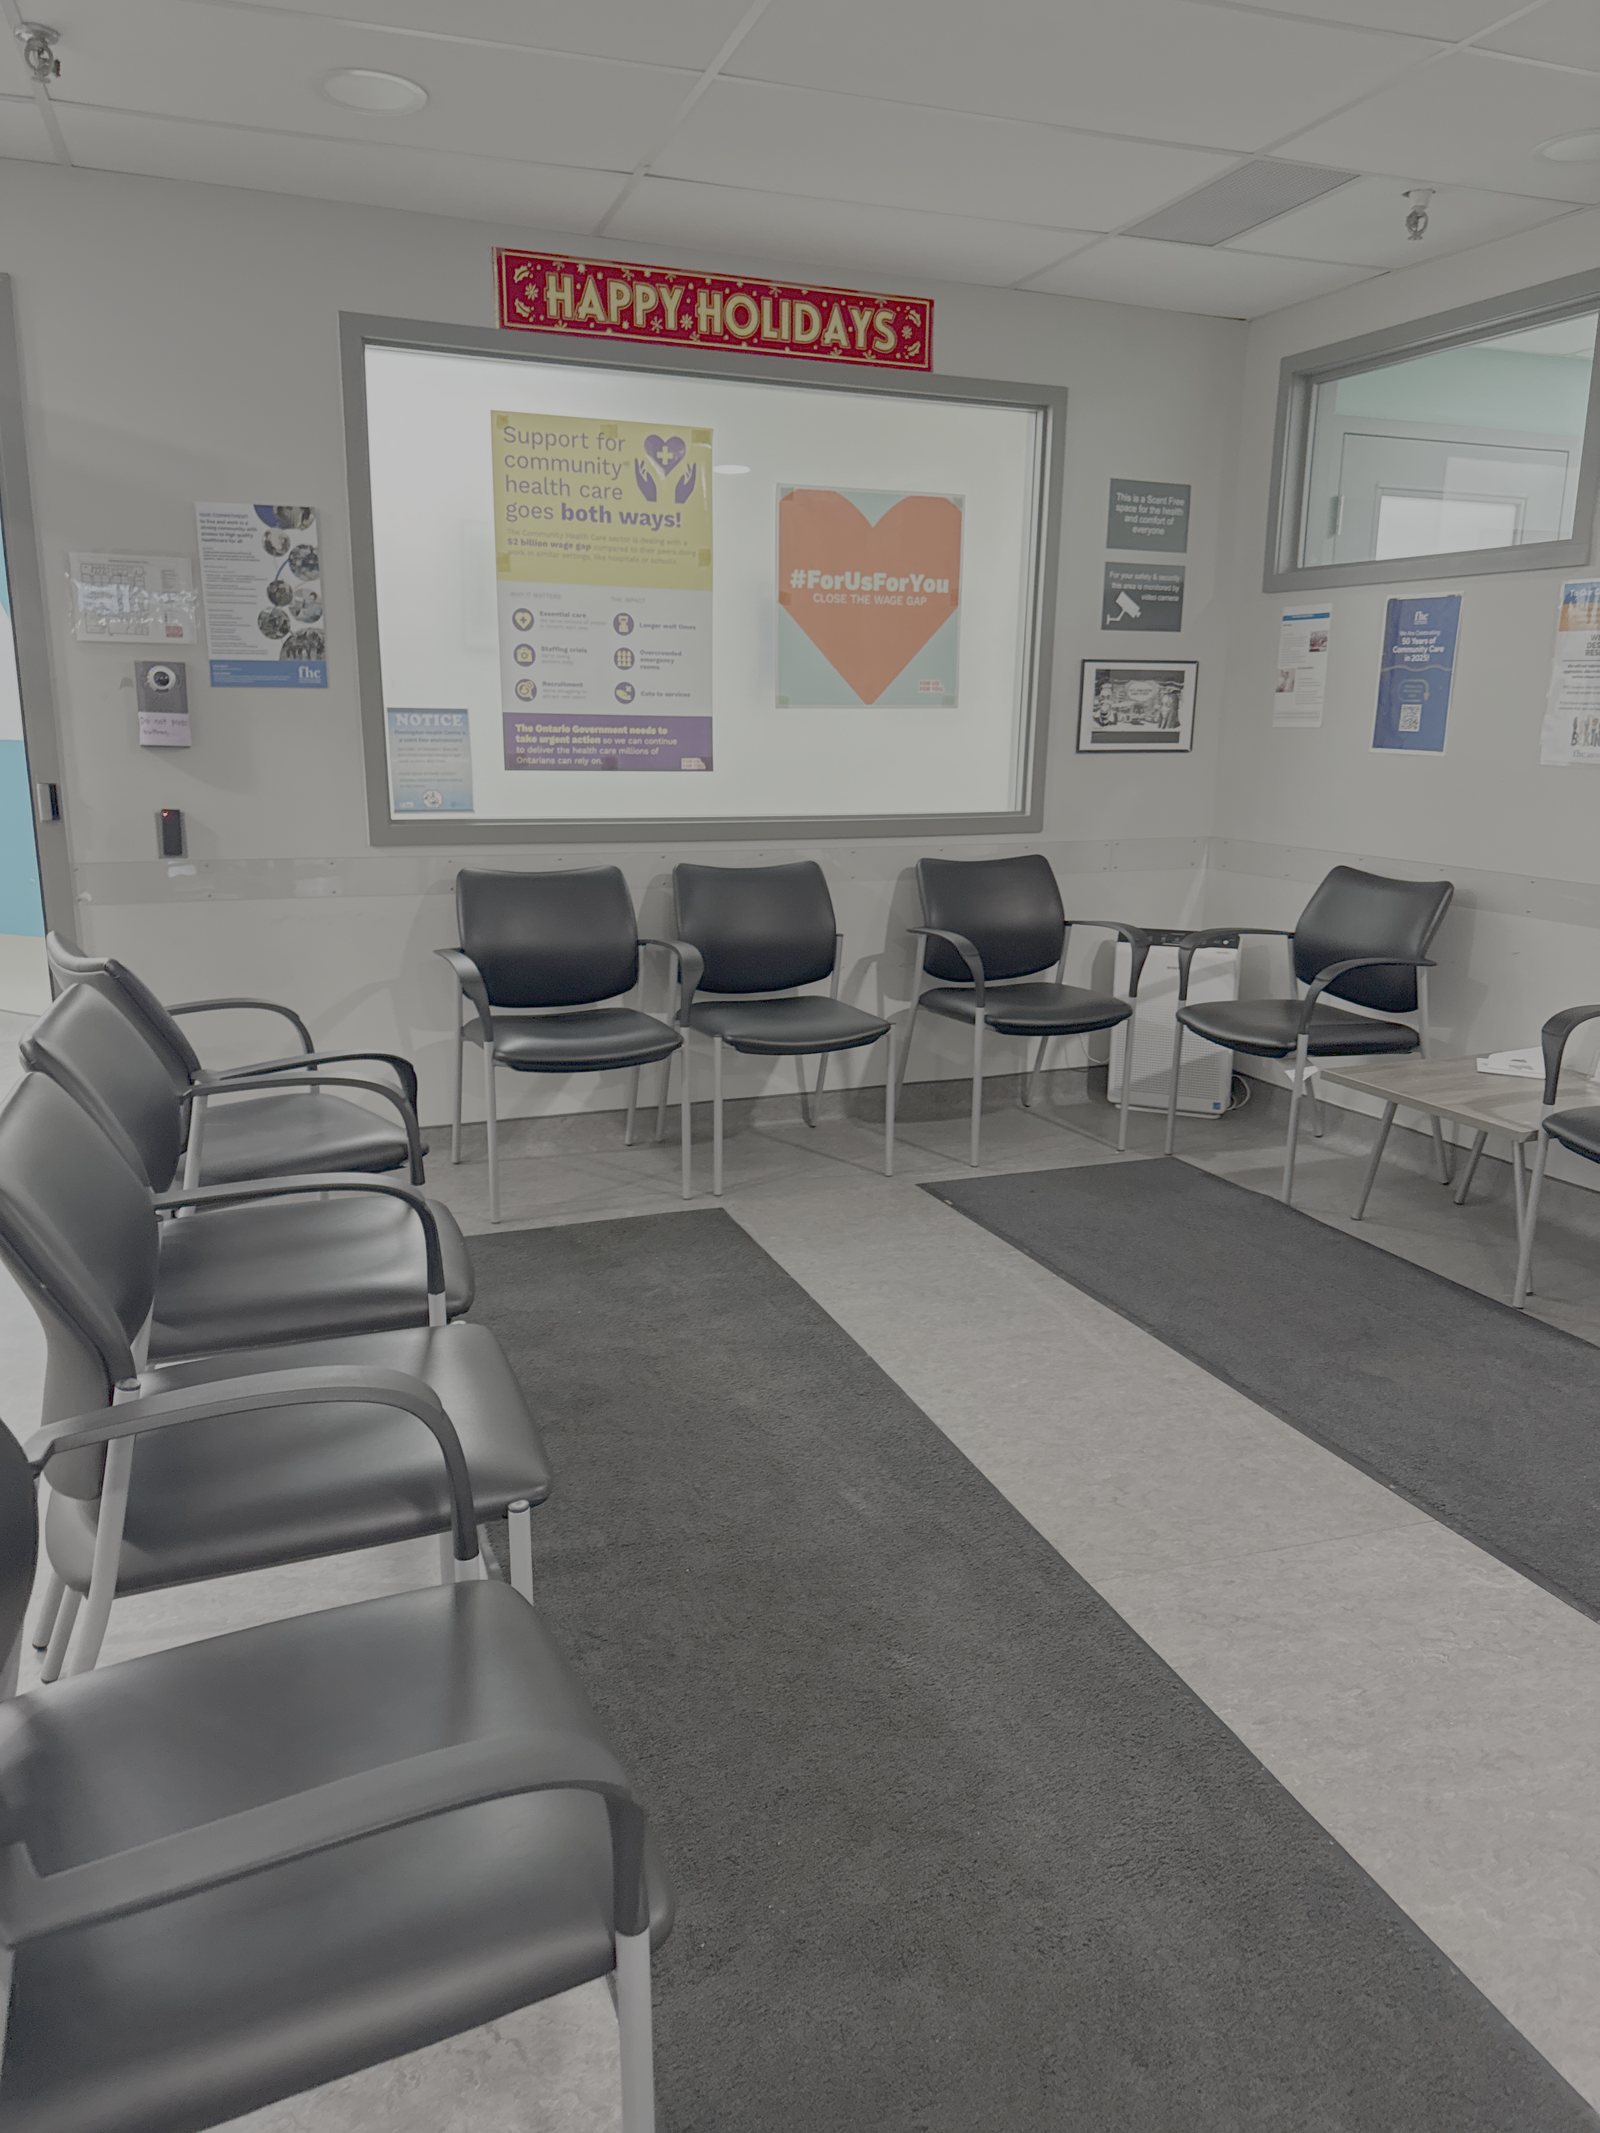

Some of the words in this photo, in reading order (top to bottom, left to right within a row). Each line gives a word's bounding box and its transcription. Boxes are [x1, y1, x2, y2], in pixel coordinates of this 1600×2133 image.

[545, 271, 685, 331] HAPPY
[697, 286, 898, 353] HOLIDAYS
[503, 426, 589, 450] Support
[596, 432, 626, 452] for
[504, 454, 622, 480] community
[505, 474, 570, 497] health
[579, 484, 623, 500] care
[1116, 492, 1131, 502] This
[1132, 494, 1139, 503] is
[1146, 494, 1167, 505] Scent
[1168, 496, 1185, 506] Free
[506, 502, 554, 522] goes
[561, 502, 612, 524] both
[619, 511, 682, 531] ways!
[1115, 504, 1137, 513] space
[1138, 504, 1148, 513] for
[1149, 506, 1161, 515] the
[1162, 507, 1184, 516] health
[1124, 515, 1138, 523] and
[1139, 516, 1165, 525] comfort
[1166, 517, 1175, 526] of
[1132, 526, 1166, 536] everyone
[521, 530, 564, 540] Community
[640, 537, 665, 547] dealing
[507, 538, 518, 546] $2
[520, 538, 548, 547] billion
[550, 542, 573, 551] wage
[576, 543, 591, 552] gap
[593, 544, 628, 553] compared
[657, 548, 676, 556] peers
[678, 549, 697, 558] doing
[536, 550, 560, 558] similar
[608, 555, 639, 564] hospitals
[790, 569, 949, 594] #ForUsForYou
[1134, 572, 1152, 582] safety
[813, 593, 847, 604] CLOSE
[850, 594, 871, 605] THE
[874, 595, 903, 606] WAGE
[906, 596, 927, 606] GAP
[1414, 611, 1429, 621] fhc
[1401, 637, 1410, 645] 50
[1429, 636, 1437, 644] of
[1392, 646, 1428, 654] Community
[1429, 645, 1445, 653] Care
[298, 665, 321, 678] fhc
[395, 714, 463, 727] NOTICE
[515, 724, 533, 733] The
[535, 724, 570, 734] Ontario
[572, 724, 628, 735] Government
[629, 727, 657, 735] needs
[658, 727, 668, 735] to
[515, 734, 538, 744] take
[539, 735, 570, 746] urgent
[572, 735, 601, 744] action
[644, 737, 678, 745] continue
[527, 745, 555, 755] deliver
[557, 746, 570, 755] the
[572, 746, 597, 755] health
[618, 746, 649, 756] millions
[651, 747, 659, 756] of
[516, 756, 555, 765] Ontarians
[574, 756, 589, 766] rely
